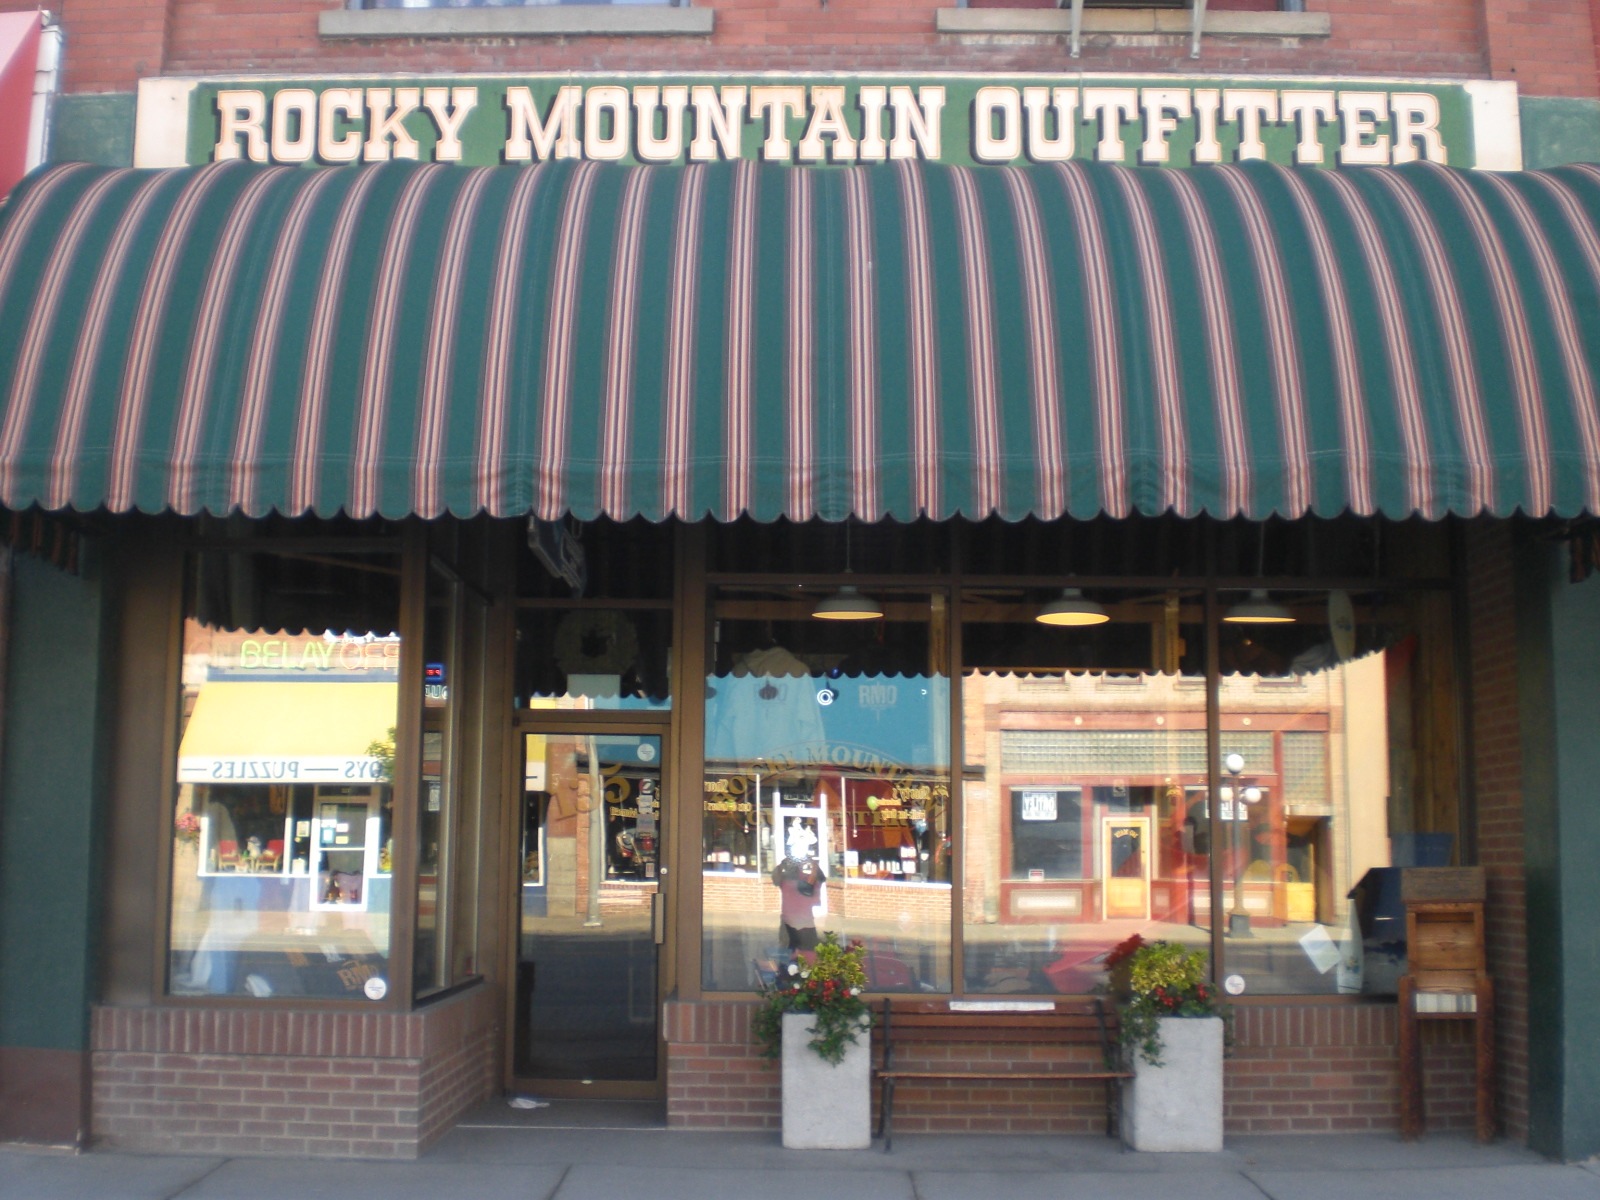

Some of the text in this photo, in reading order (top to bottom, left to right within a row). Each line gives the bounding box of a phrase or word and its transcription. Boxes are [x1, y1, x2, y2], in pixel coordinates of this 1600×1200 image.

[213, 84, 1449, 166] ROCKY MOUNTAIN OUTFITTER
[241, 639, 336, 669] BELAY
[858, 684, 898, 705] RMO
